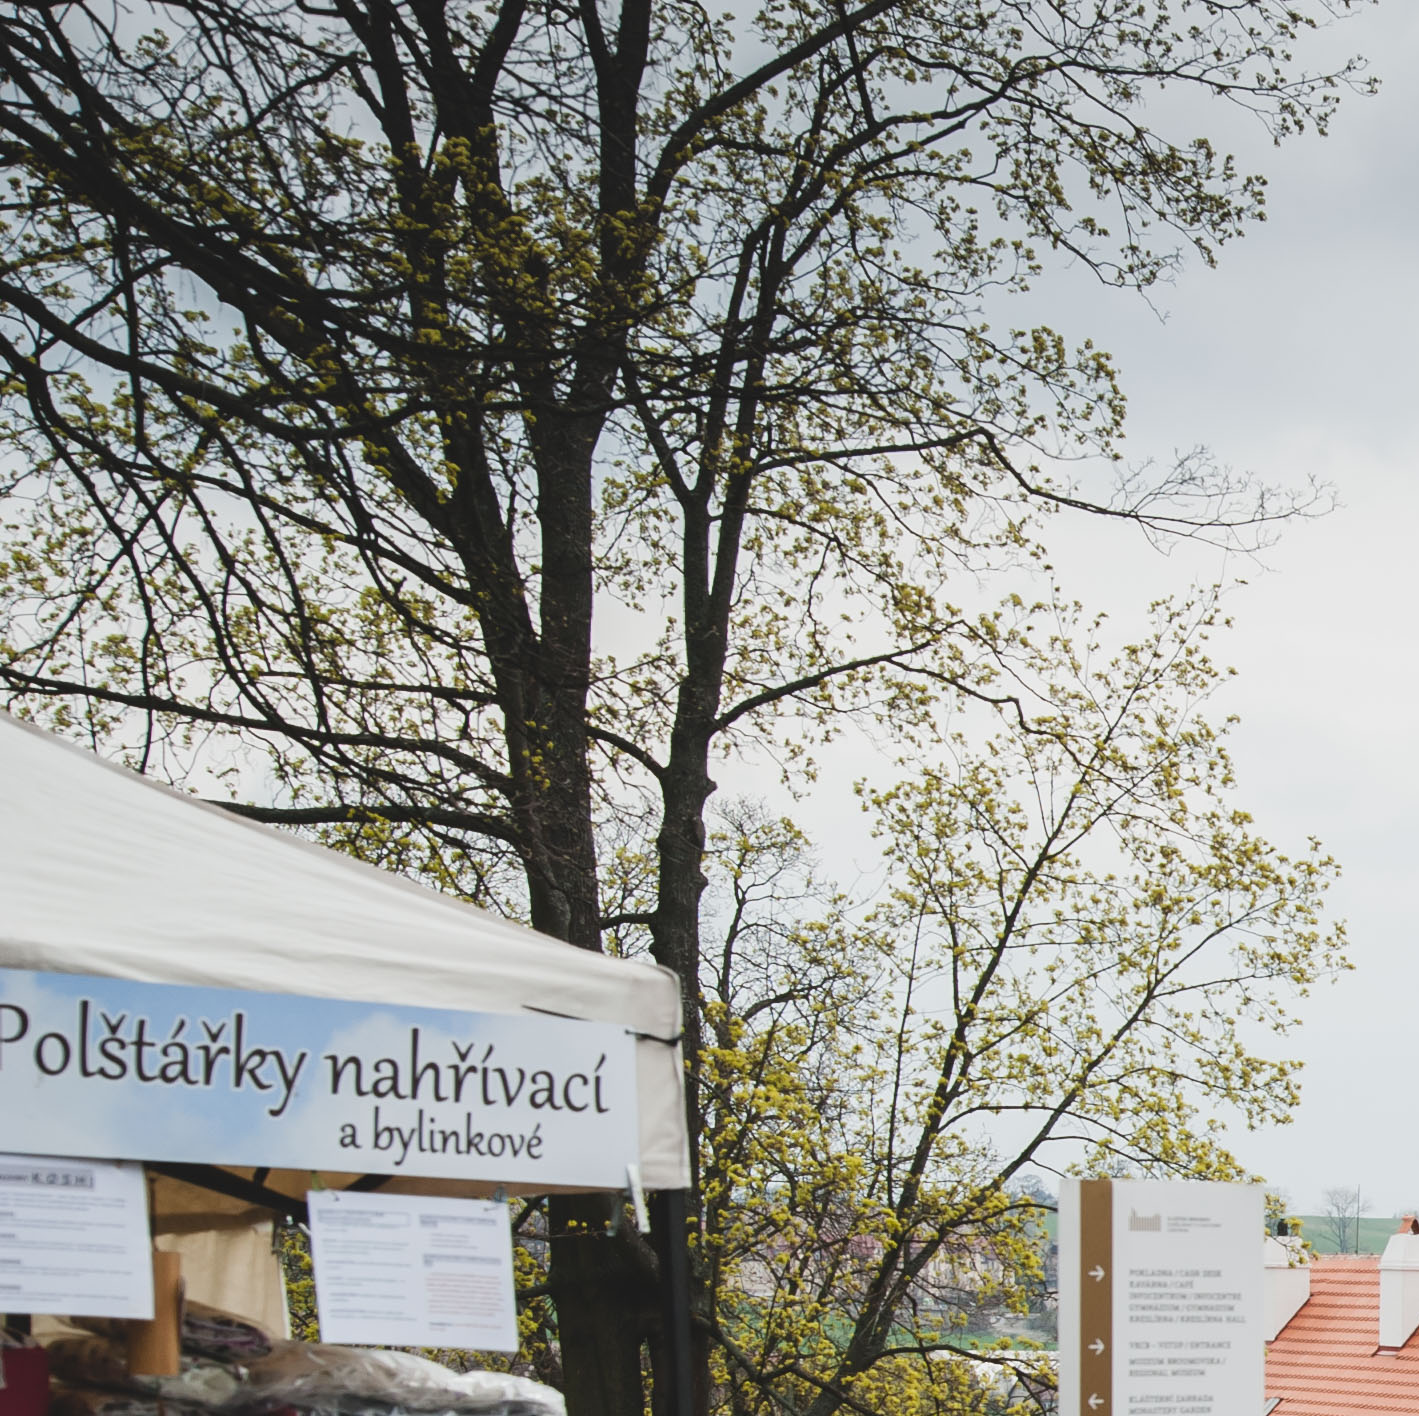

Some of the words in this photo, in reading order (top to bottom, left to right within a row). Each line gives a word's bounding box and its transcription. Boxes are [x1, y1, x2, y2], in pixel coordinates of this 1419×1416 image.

[0, 1000, 307, 1116] Polštářky
[324, 1028, 609, 1114] nahřívací
[339, 1122, 361, 1149] a
[373, 1106, 543, 1165] bylinkové
